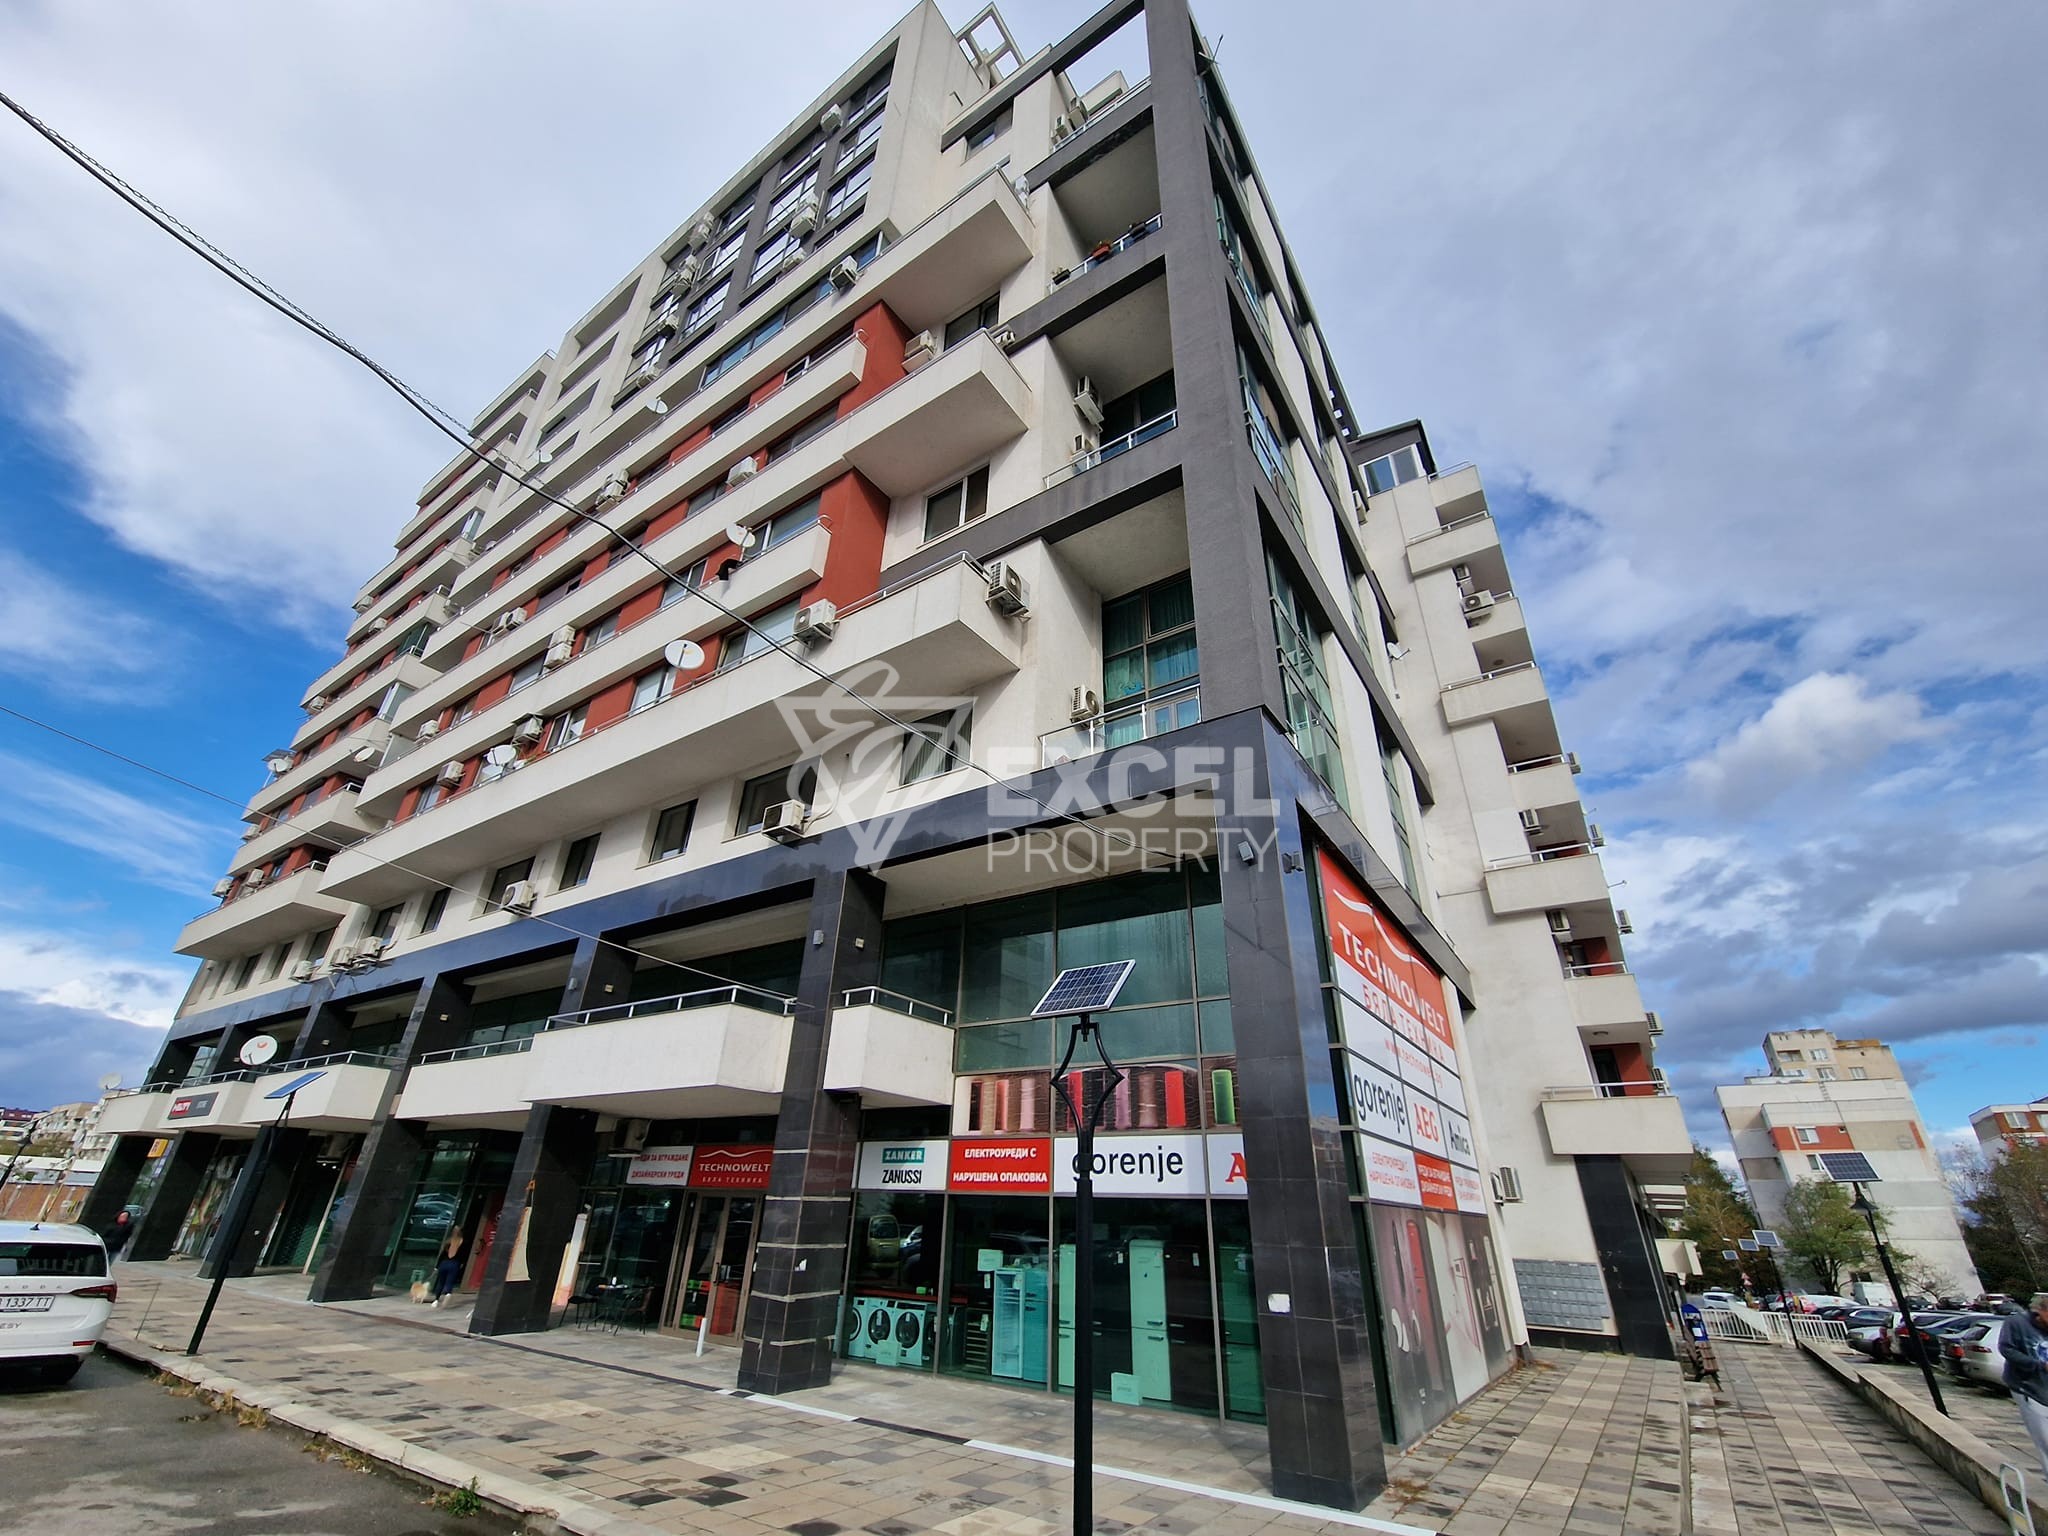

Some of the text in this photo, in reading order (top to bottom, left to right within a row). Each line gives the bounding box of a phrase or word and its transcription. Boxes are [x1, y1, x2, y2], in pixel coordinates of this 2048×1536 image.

[1337, 921, 1447, 1037] TECHNOWELT
[1362, 984, 1398, 1026] БЯЛА
[1353, 1074, 1406, 1134] gorenje
[1413, 1103, 1440, 1143] AEG
[1448, 1121, 1471, 1156] Amica
[699, 1163, 771, 1173] TECHNOWELT
[884, 1150, 923, 1161] ZANKER
[964, 1147, 1037, 1160] ЕЛЕКТРОУРЕДИ С
[1225, 1152, 1248, 1183] A
[882, 1169, 922, 1184] ZANUSSI
[953, 1172, 1048, 1183] НАРУШЕНА ОПАКОВКА
